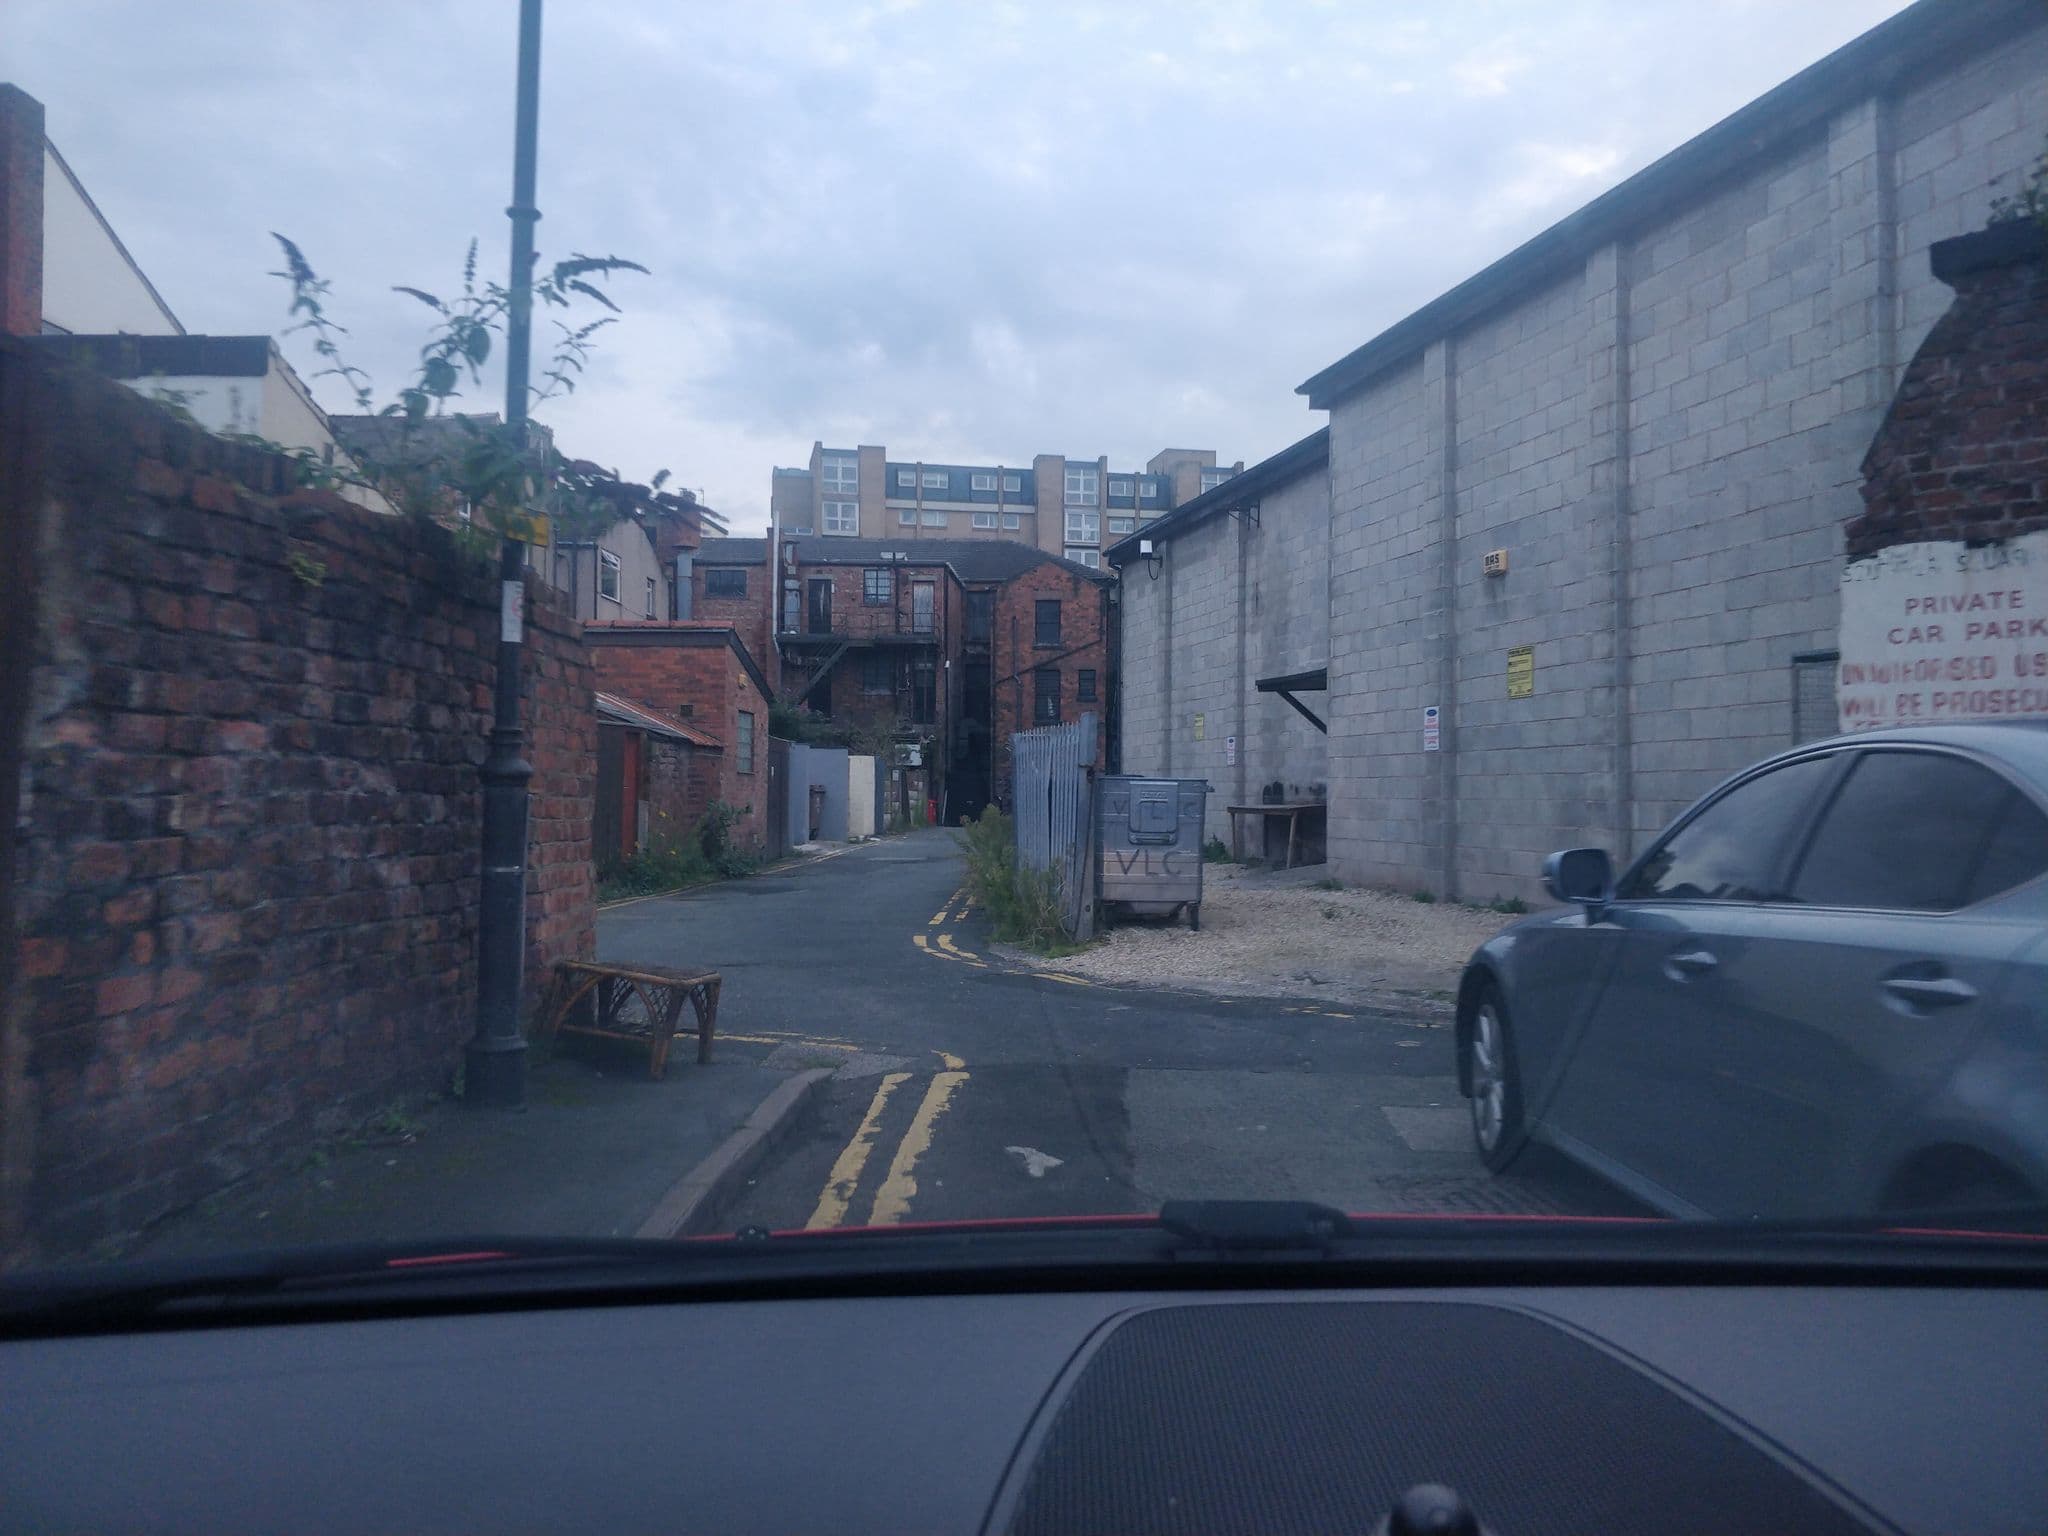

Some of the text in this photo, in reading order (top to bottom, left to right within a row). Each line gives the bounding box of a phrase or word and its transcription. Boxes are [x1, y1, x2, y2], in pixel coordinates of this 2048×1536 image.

[1904, 590, 2024, 616] PRIVATE
[1888, 619, 2048, 645] CAR PARK
[1115, 848, 1182, 877] VLC
